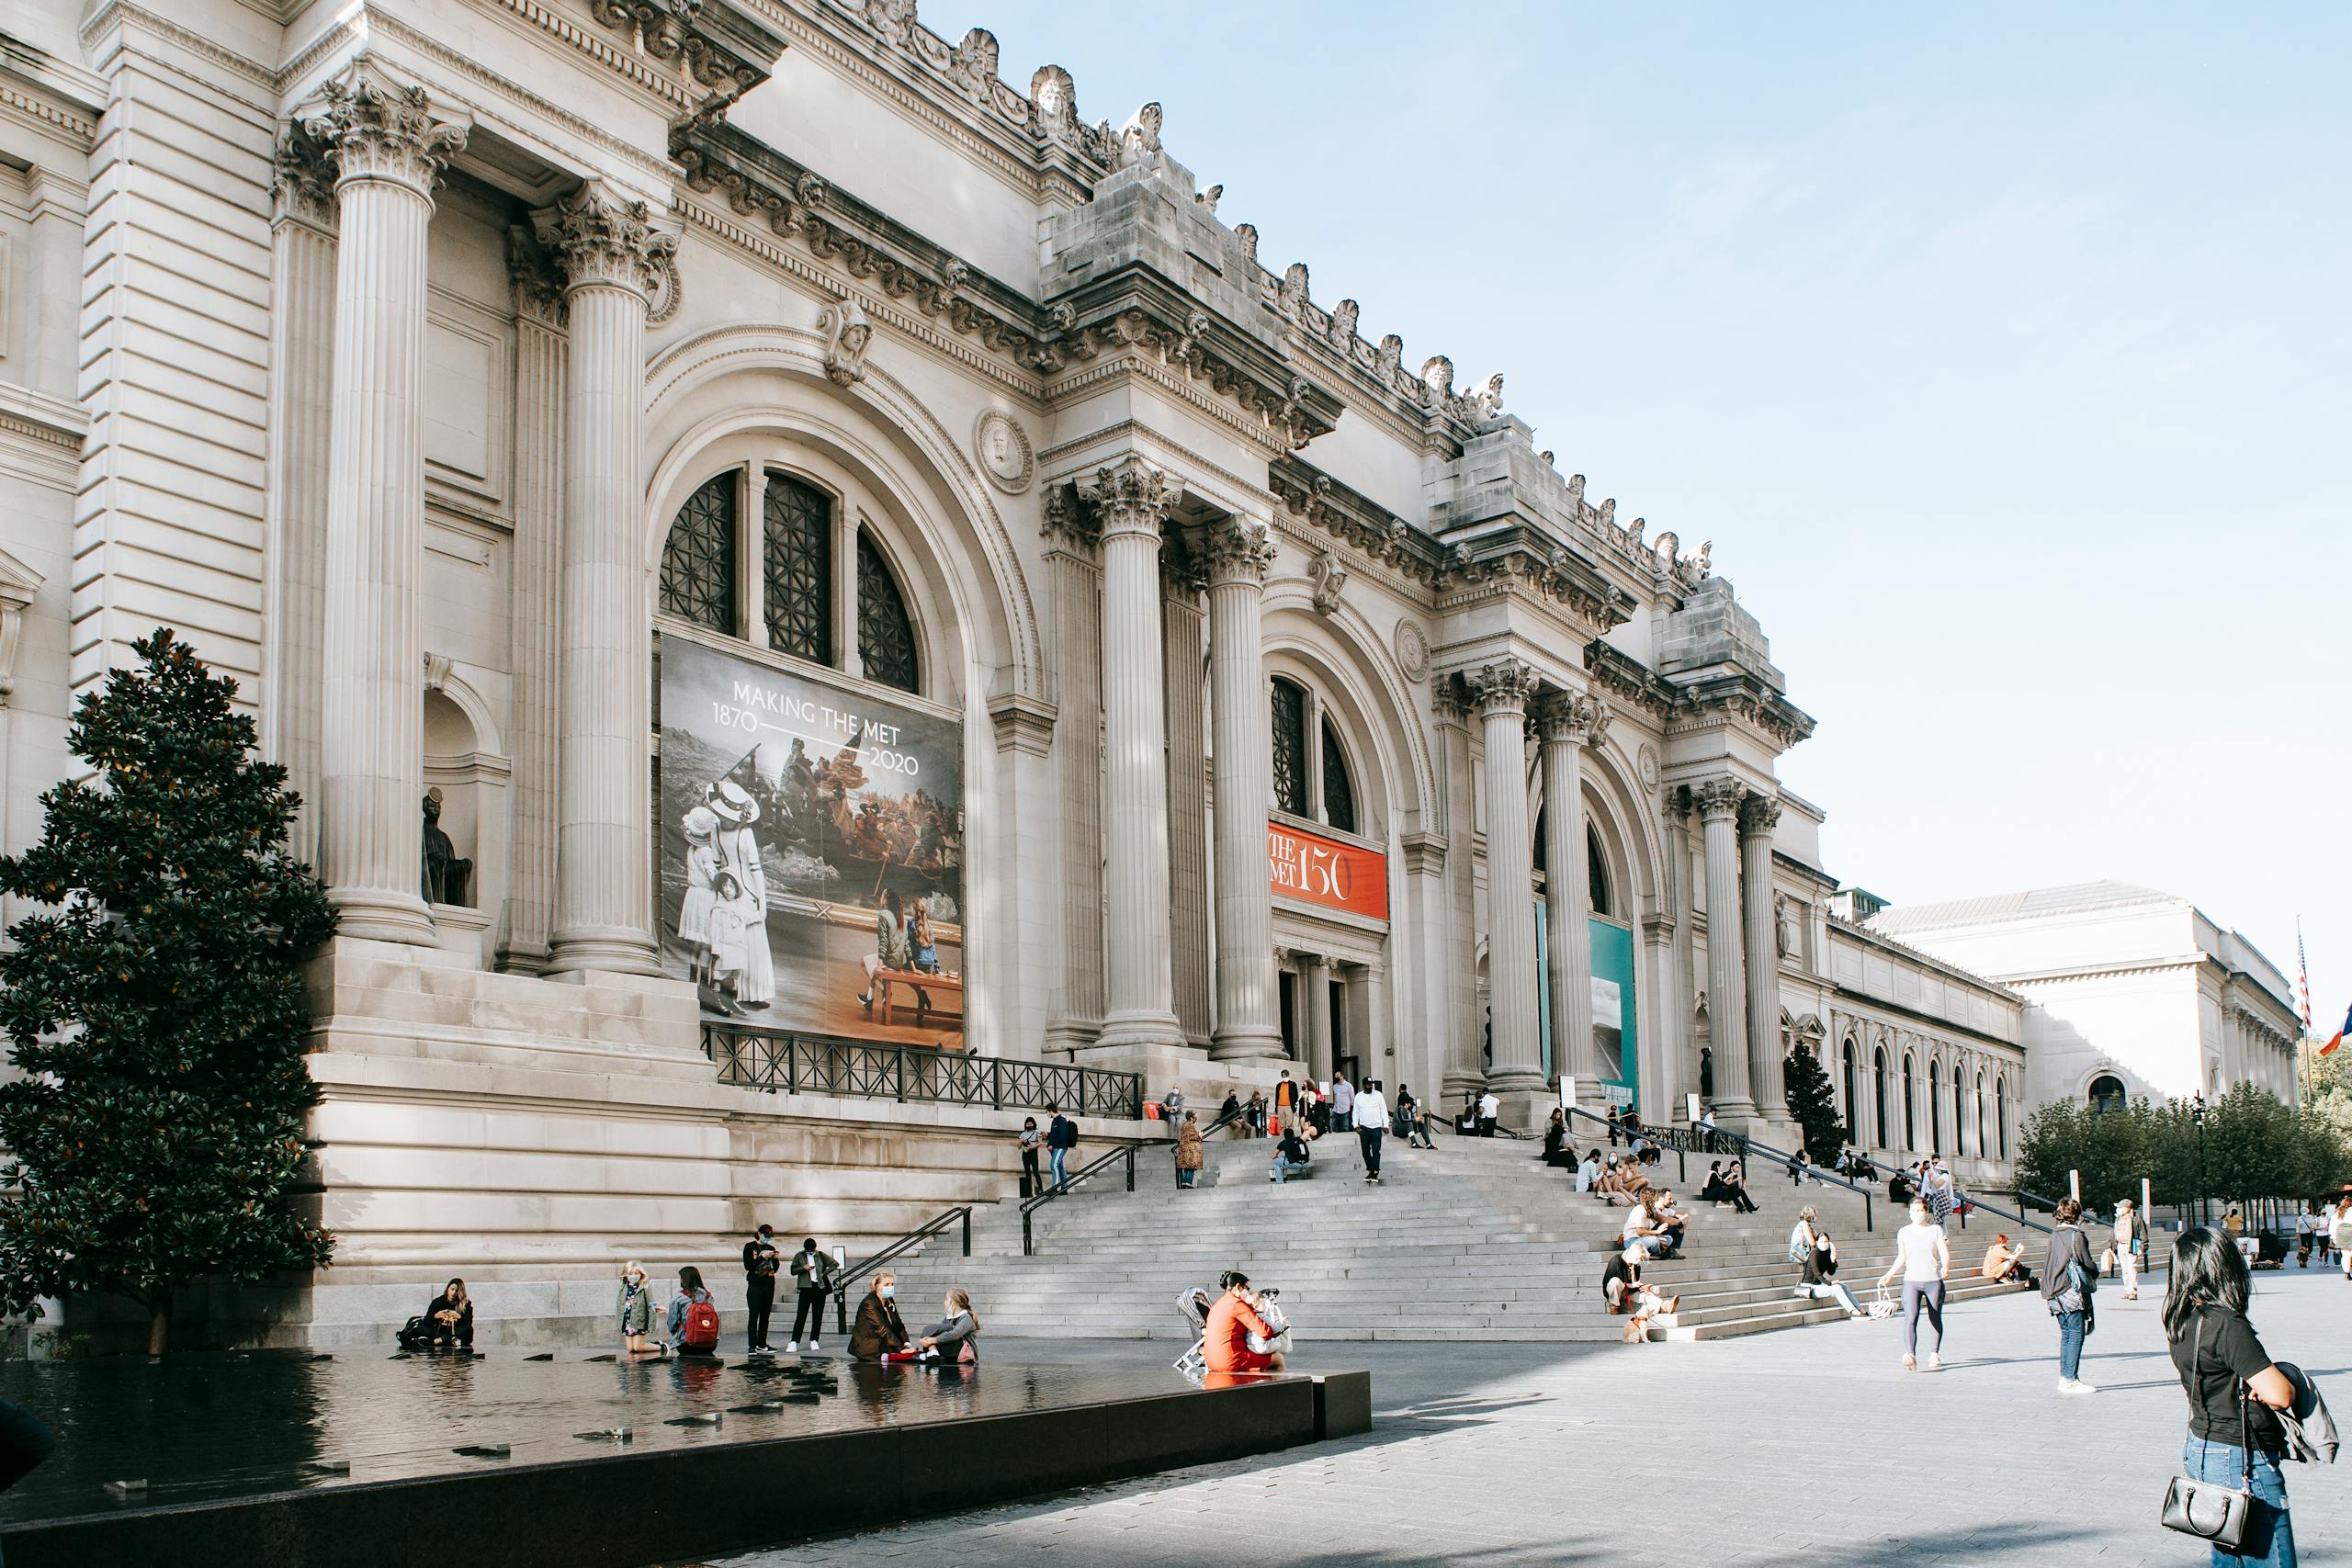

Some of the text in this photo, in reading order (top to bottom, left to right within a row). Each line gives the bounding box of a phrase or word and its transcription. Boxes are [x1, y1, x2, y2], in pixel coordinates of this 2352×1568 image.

[712, 702, 919, 776] 1870 2020
[734, 680, 901, 746] MAKING THE MET
[1269, 832, 1296, 863] THE
[1269, 858, 1297, 887] MET
[1298, 842, 1352, 900] 150
